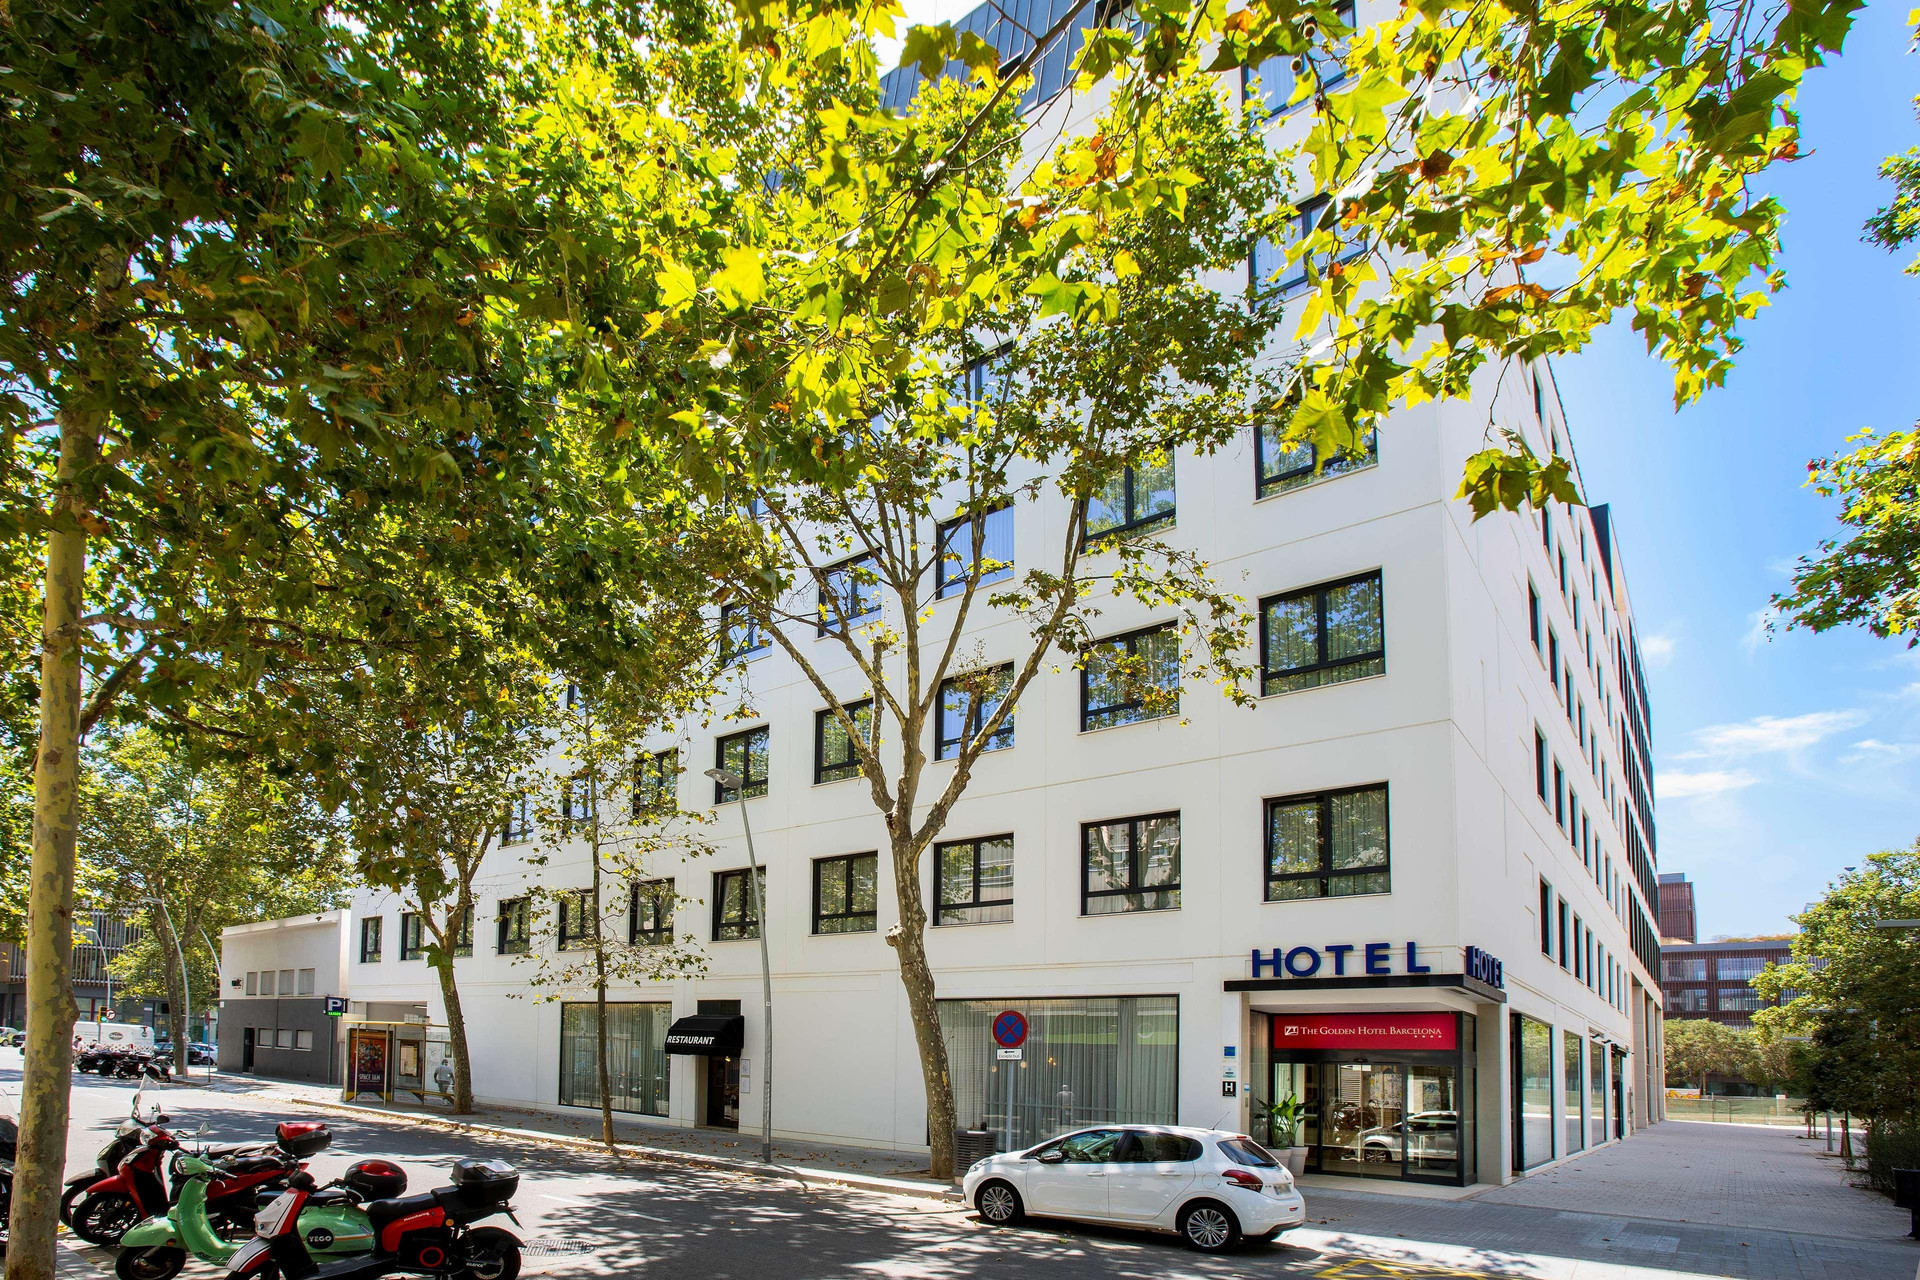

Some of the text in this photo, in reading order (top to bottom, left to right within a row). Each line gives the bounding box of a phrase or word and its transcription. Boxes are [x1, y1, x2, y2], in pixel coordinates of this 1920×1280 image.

[1251, 941, 1431, 978] HOTEL
[1465, 945, 1504, 989] HOTEL
[328, 999, 342, 1011] P
[1319, 1026, 1356, 1035] GOLDEN
[1358, 1026, 1388, 1035] HOTEL
[1389, 1026, 1442, 1035] BARCELONA
[666, 1035, 715, 1045] RESTAURANT
[1225, 1082, 1234, 1092] H
[308, 1235, 332, 1243] YEGO
